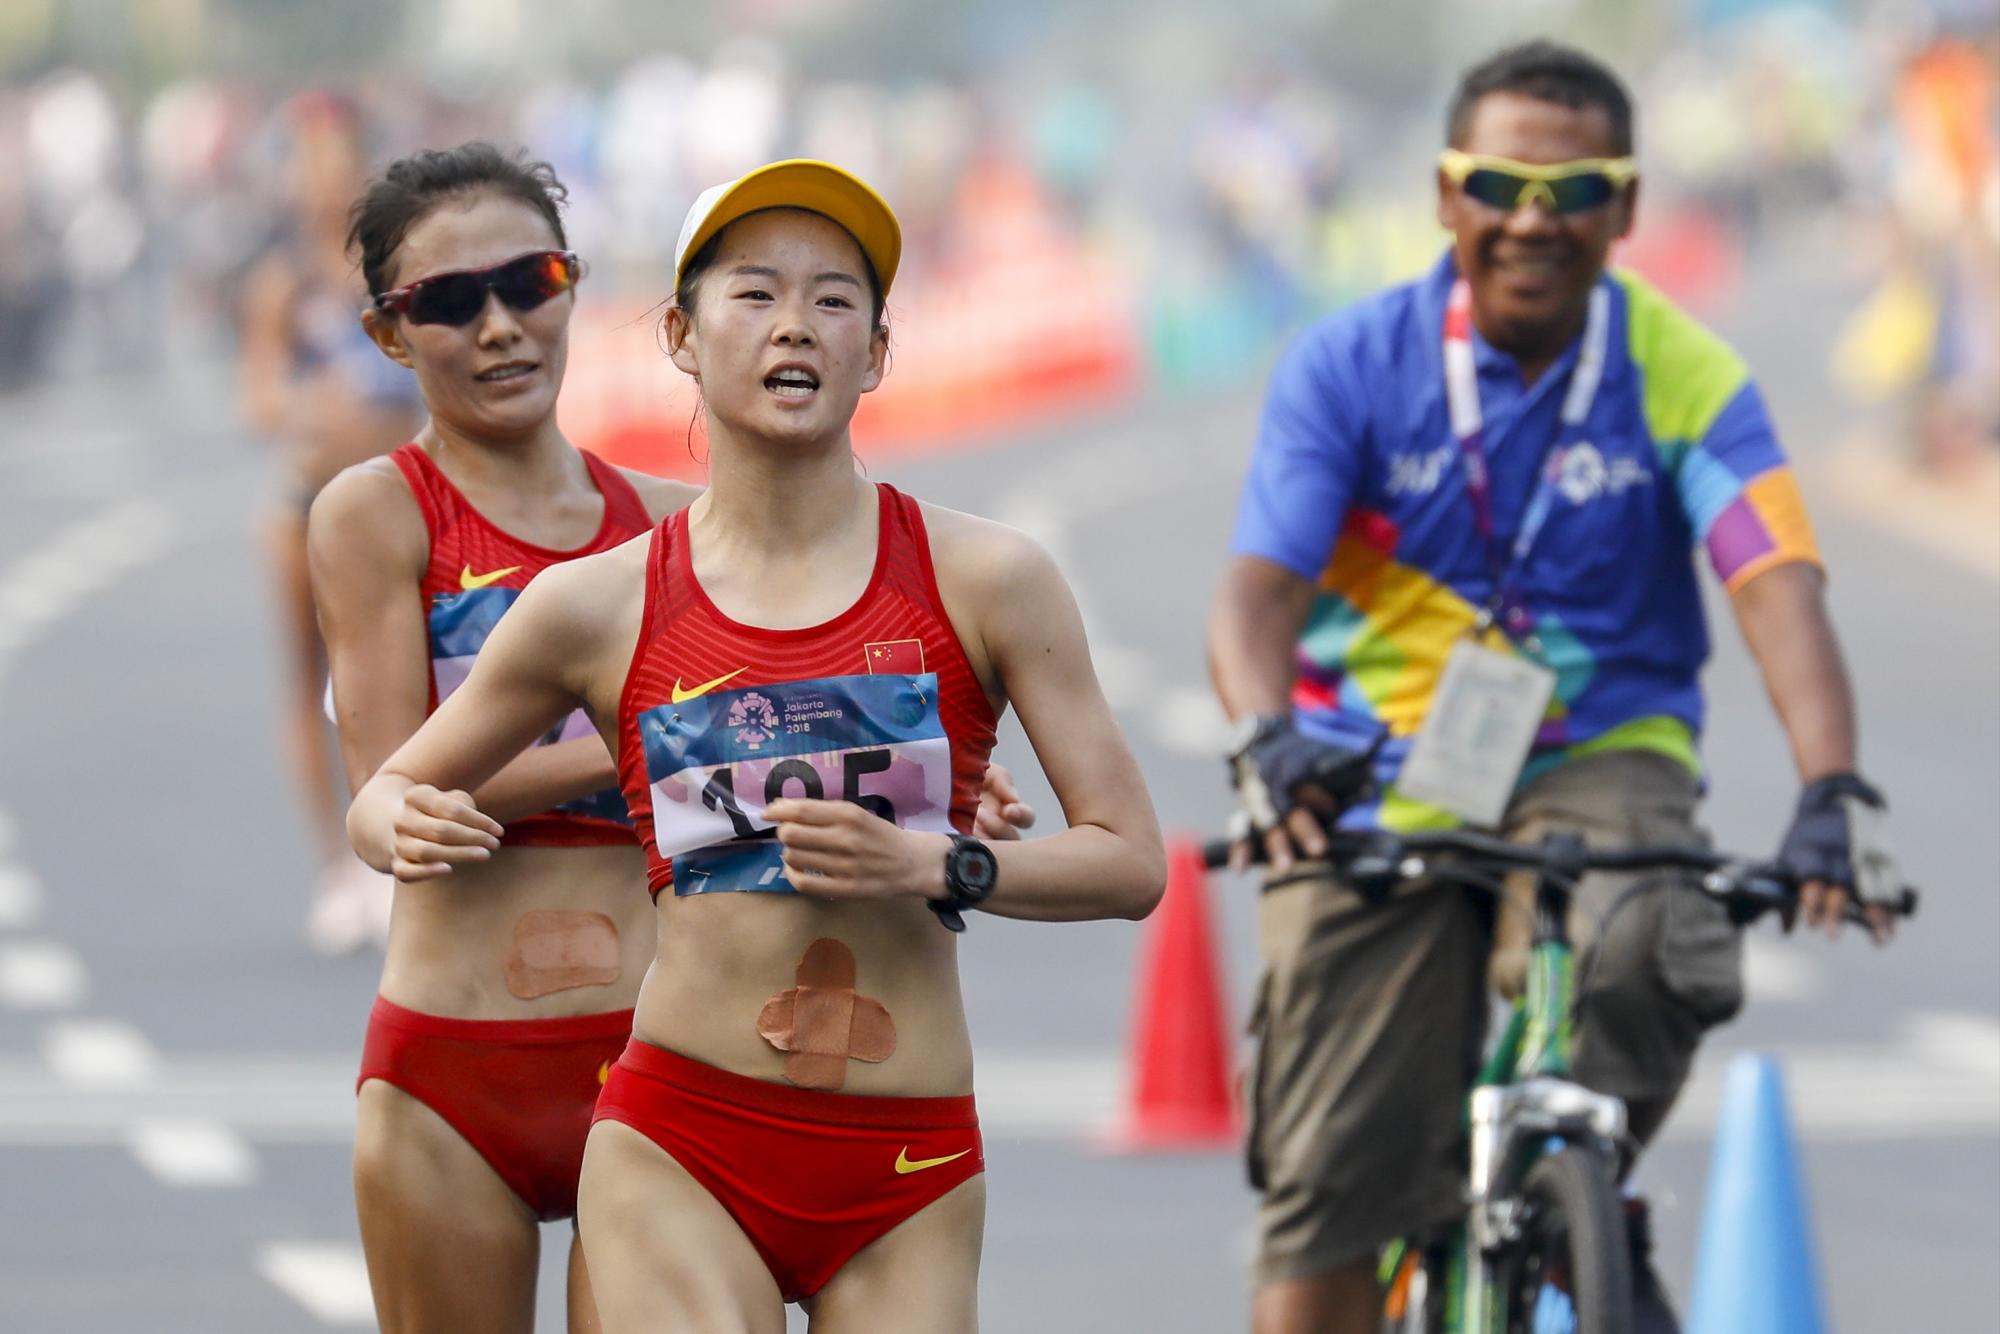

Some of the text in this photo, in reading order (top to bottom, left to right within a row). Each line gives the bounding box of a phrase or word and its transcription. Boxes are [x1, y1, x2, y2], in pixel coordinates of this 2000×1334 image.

[784, 701, 824, 712] Jakarta
[784, 709, 843, 722] Palembang
[786, 721, 811, 734] 2018
